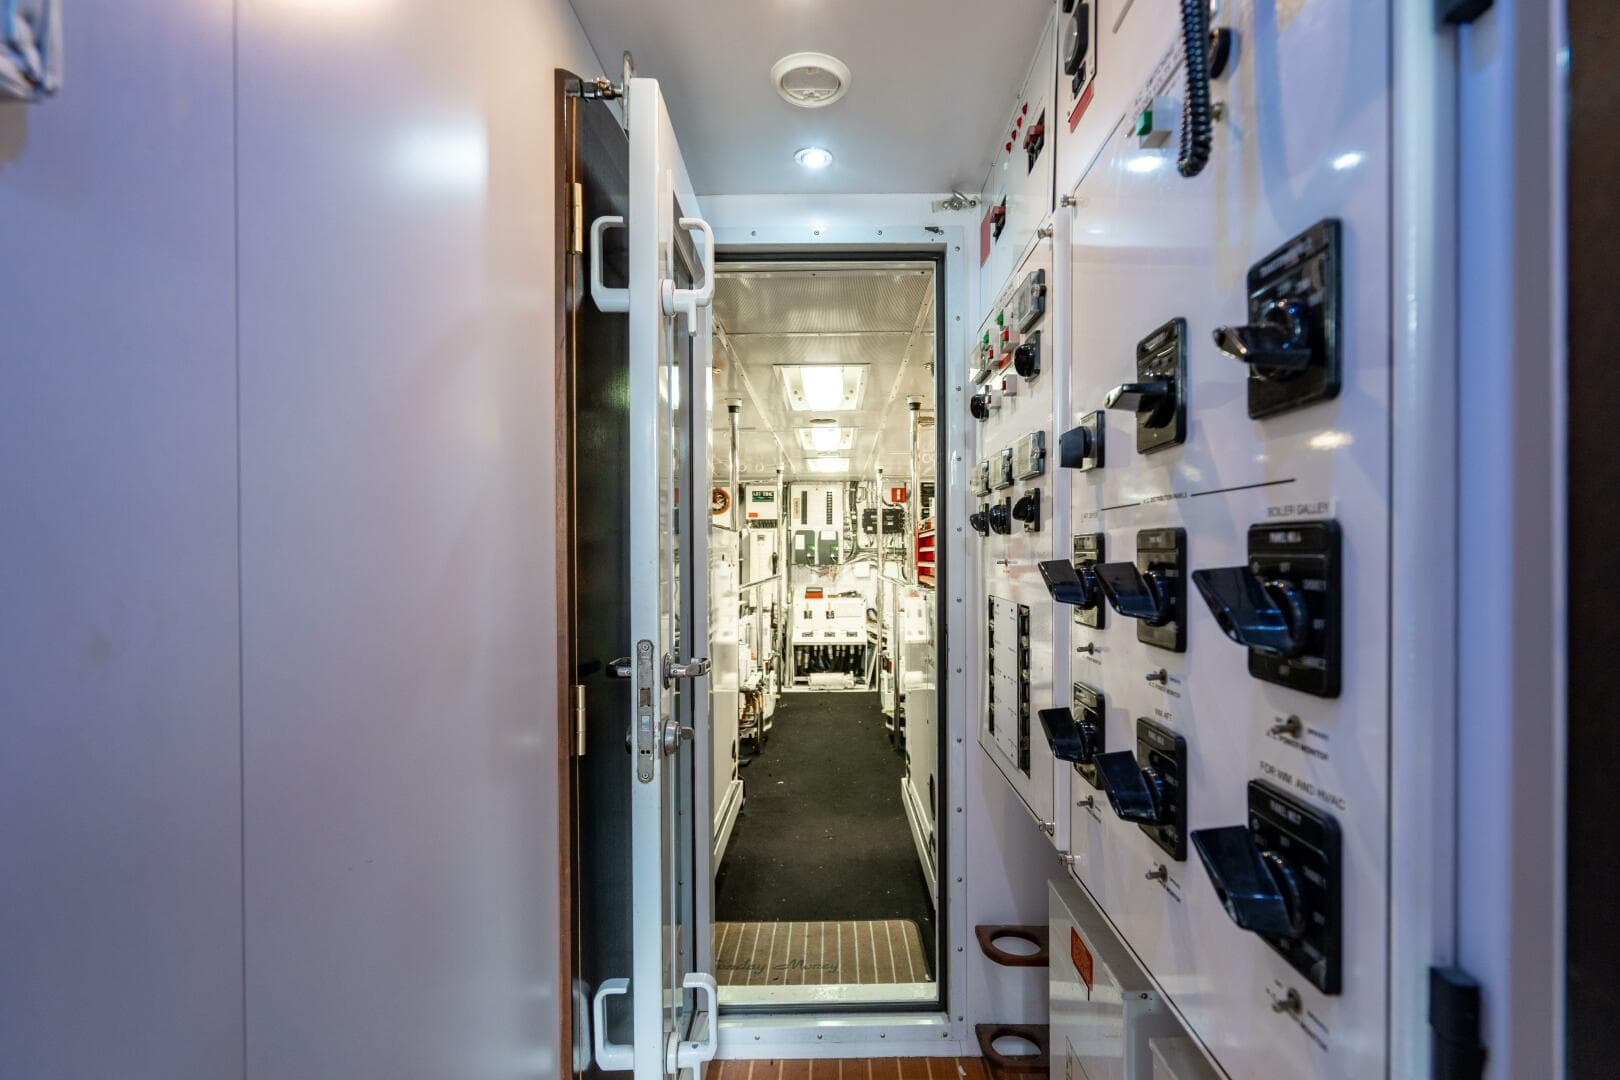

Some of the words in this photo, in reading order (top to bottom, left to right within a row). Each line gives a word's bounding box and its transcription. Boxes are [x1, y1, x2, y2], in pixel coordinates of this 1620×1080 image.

[1259, 760, 1276, 775] FOR
[1296, 777, 1315, 795] AND
[1317, 790, 1346, 811] HVAC
